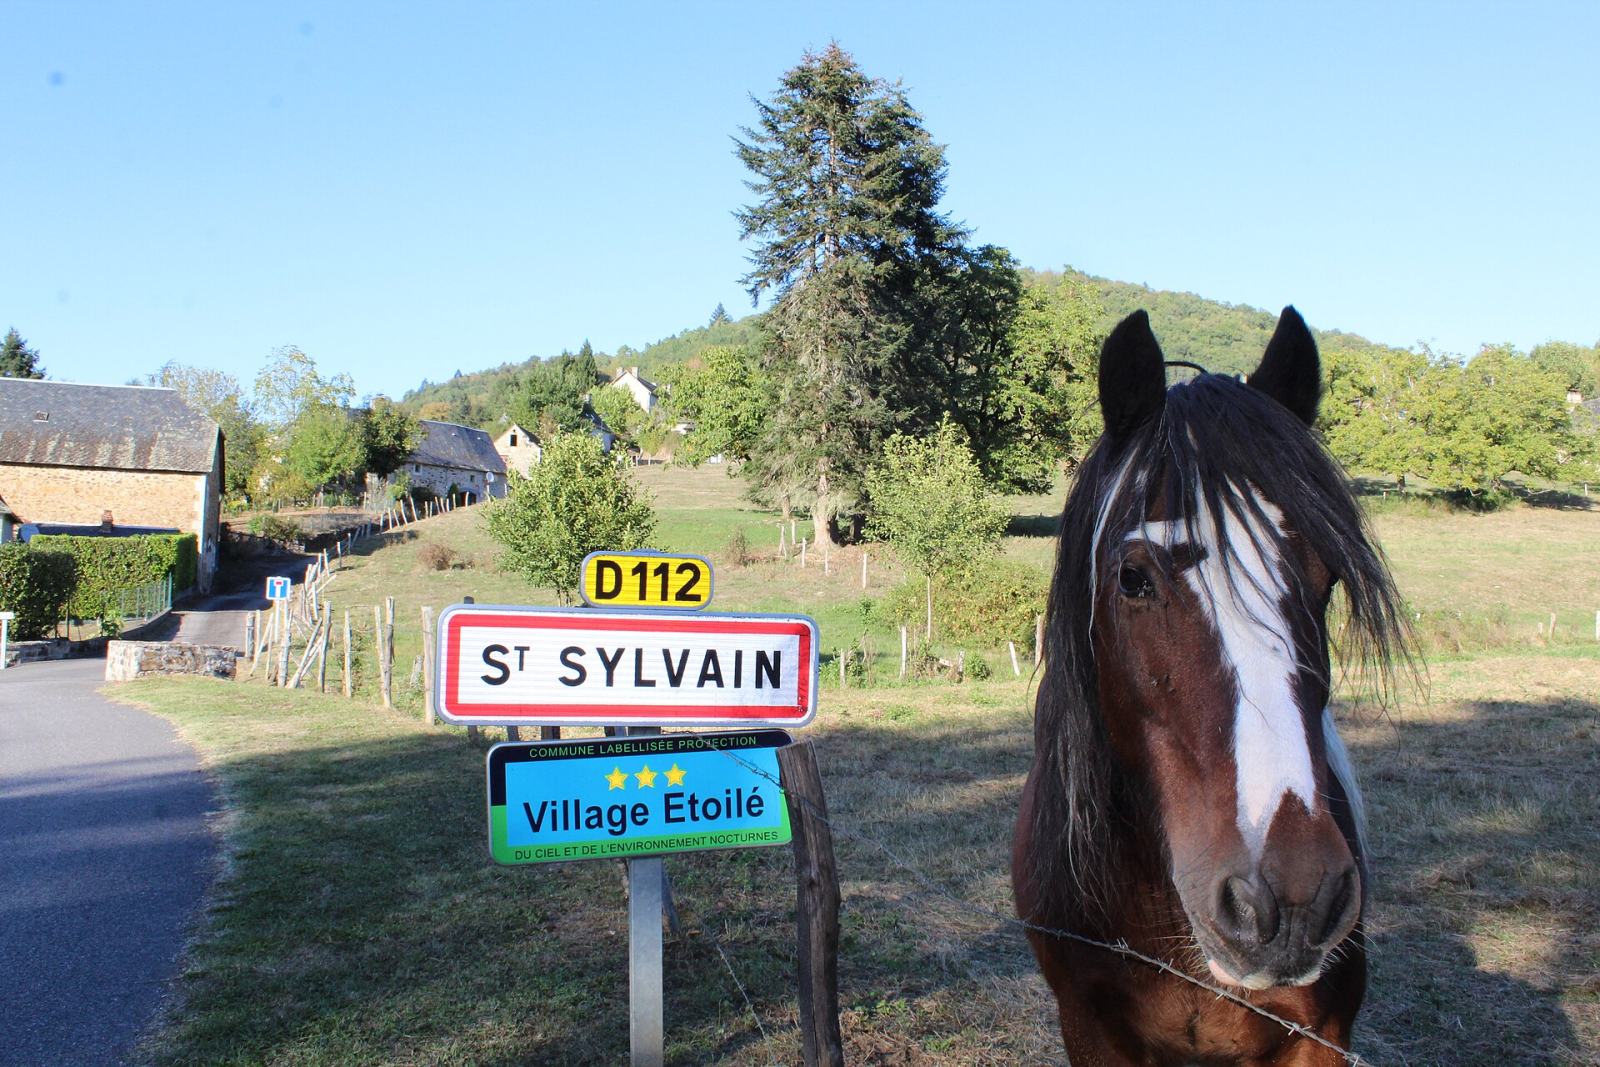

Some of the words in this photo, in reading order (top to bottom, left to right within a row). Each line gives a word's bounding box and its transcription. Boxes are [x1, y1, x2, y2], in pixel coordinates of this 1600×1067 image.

[595, 560, 701, 602] D112
[558, 646, 782, 689] SYLVAIN
[529, 745, 595, 758] COMMUNE
[600, 739, 674, 755] LABELLISÉE
[523, 799, 649, 836] Village
[664, 786, 765, 825] Etoilé
[515, 850, 532, 860] DU
[535, 847, 561, 858] CIEL
[564, 846, 579, 856] ET
[582, 844, 597, 855] DE
[601, 836, 707, 854] L'ENVIRONNEMENT
[710, 831, 778, 845] NOCTURNES
